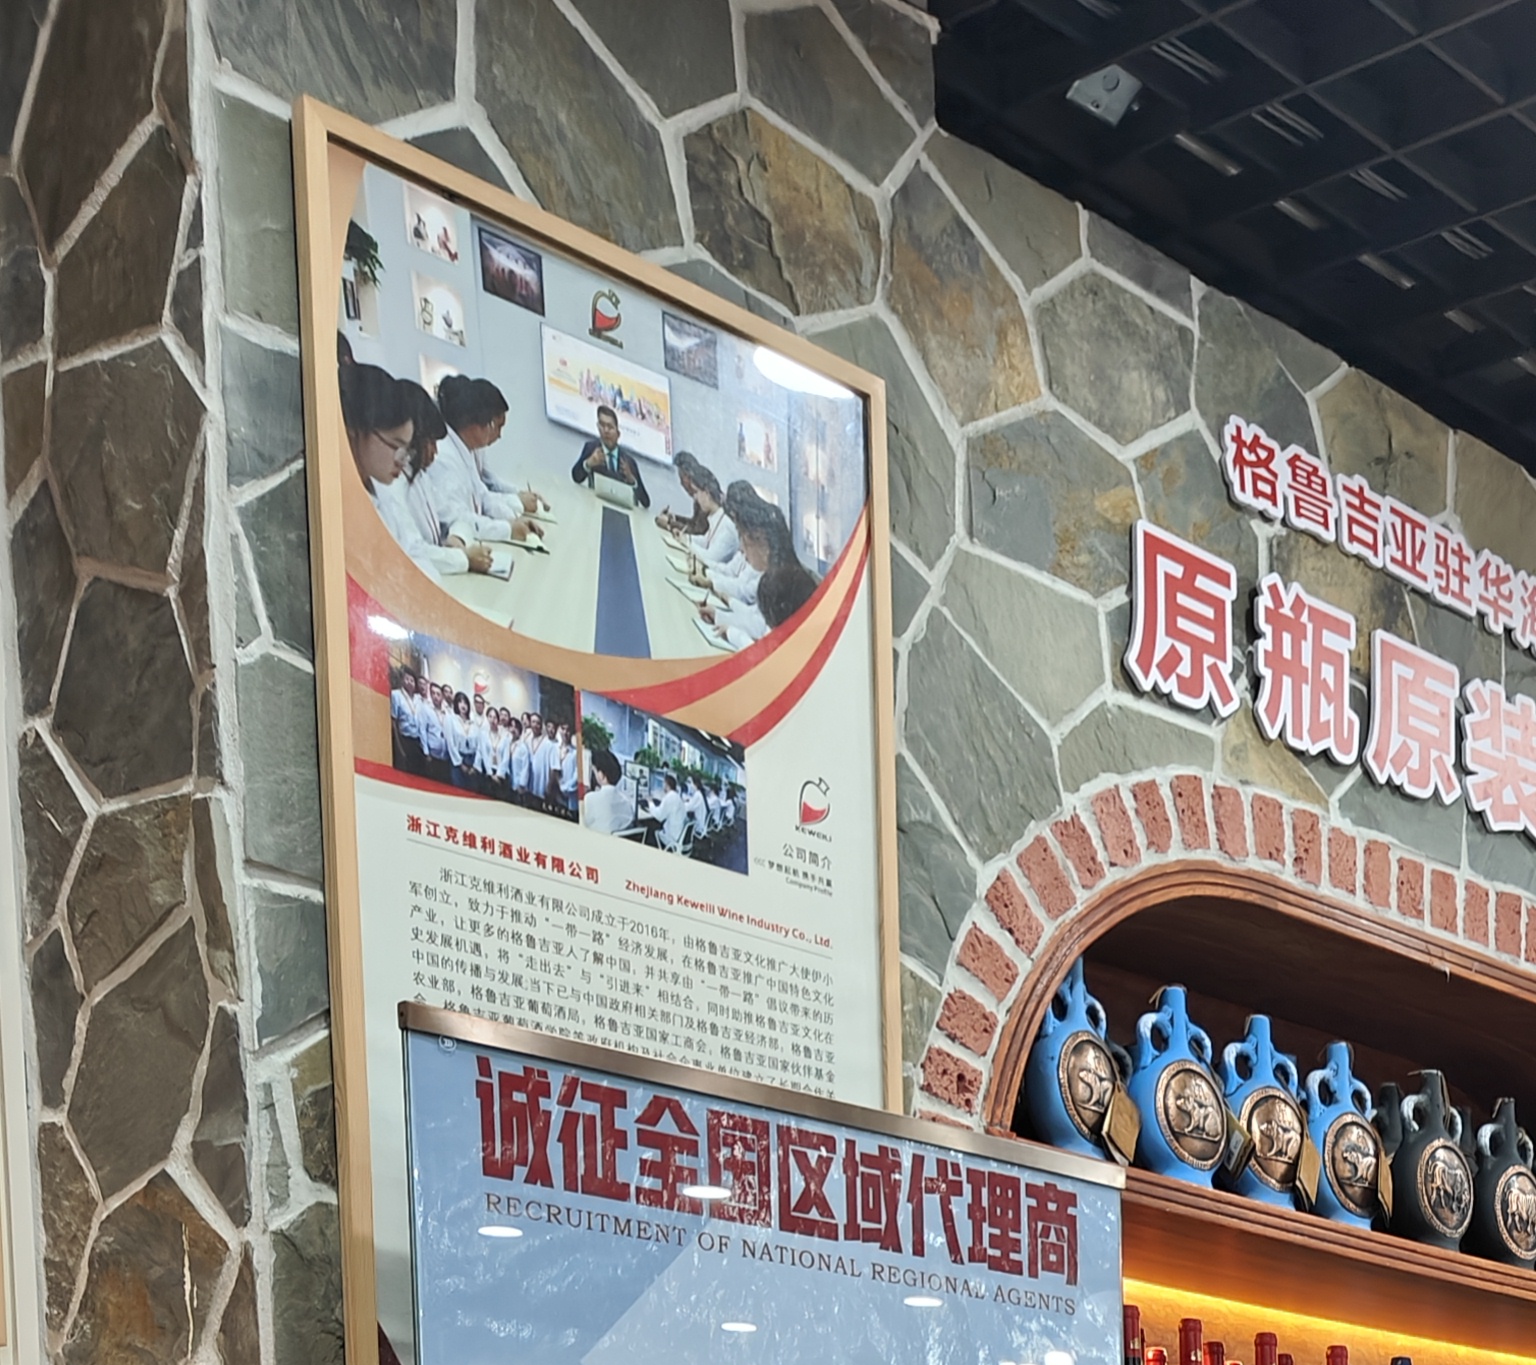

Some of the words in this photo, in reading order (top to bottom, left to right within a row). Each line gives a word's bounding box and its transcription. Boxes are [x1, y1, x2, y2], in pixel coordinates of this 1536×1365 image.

[406, 814, 601, 885] 浙江克维利酒业有限公司
[782, 843, 832, 871] 公司简介
[625, 879, 674, 906] Zhejiang
[717, 905, 746, 924] Wine
[747, 911, 790, 940] Industry
[475, 1055, 1078, 1287] 诚征全国区域代理商
[484, 1193, 686, 1246] RECRUITMENT
[698, 1232, 731, 1252] OF
[742, 1239, 862, 1278] NATIONAL
[870, 1263, 986, 1299] REGIONAL
[993, 1286, 1077, 1316] AGENTS
